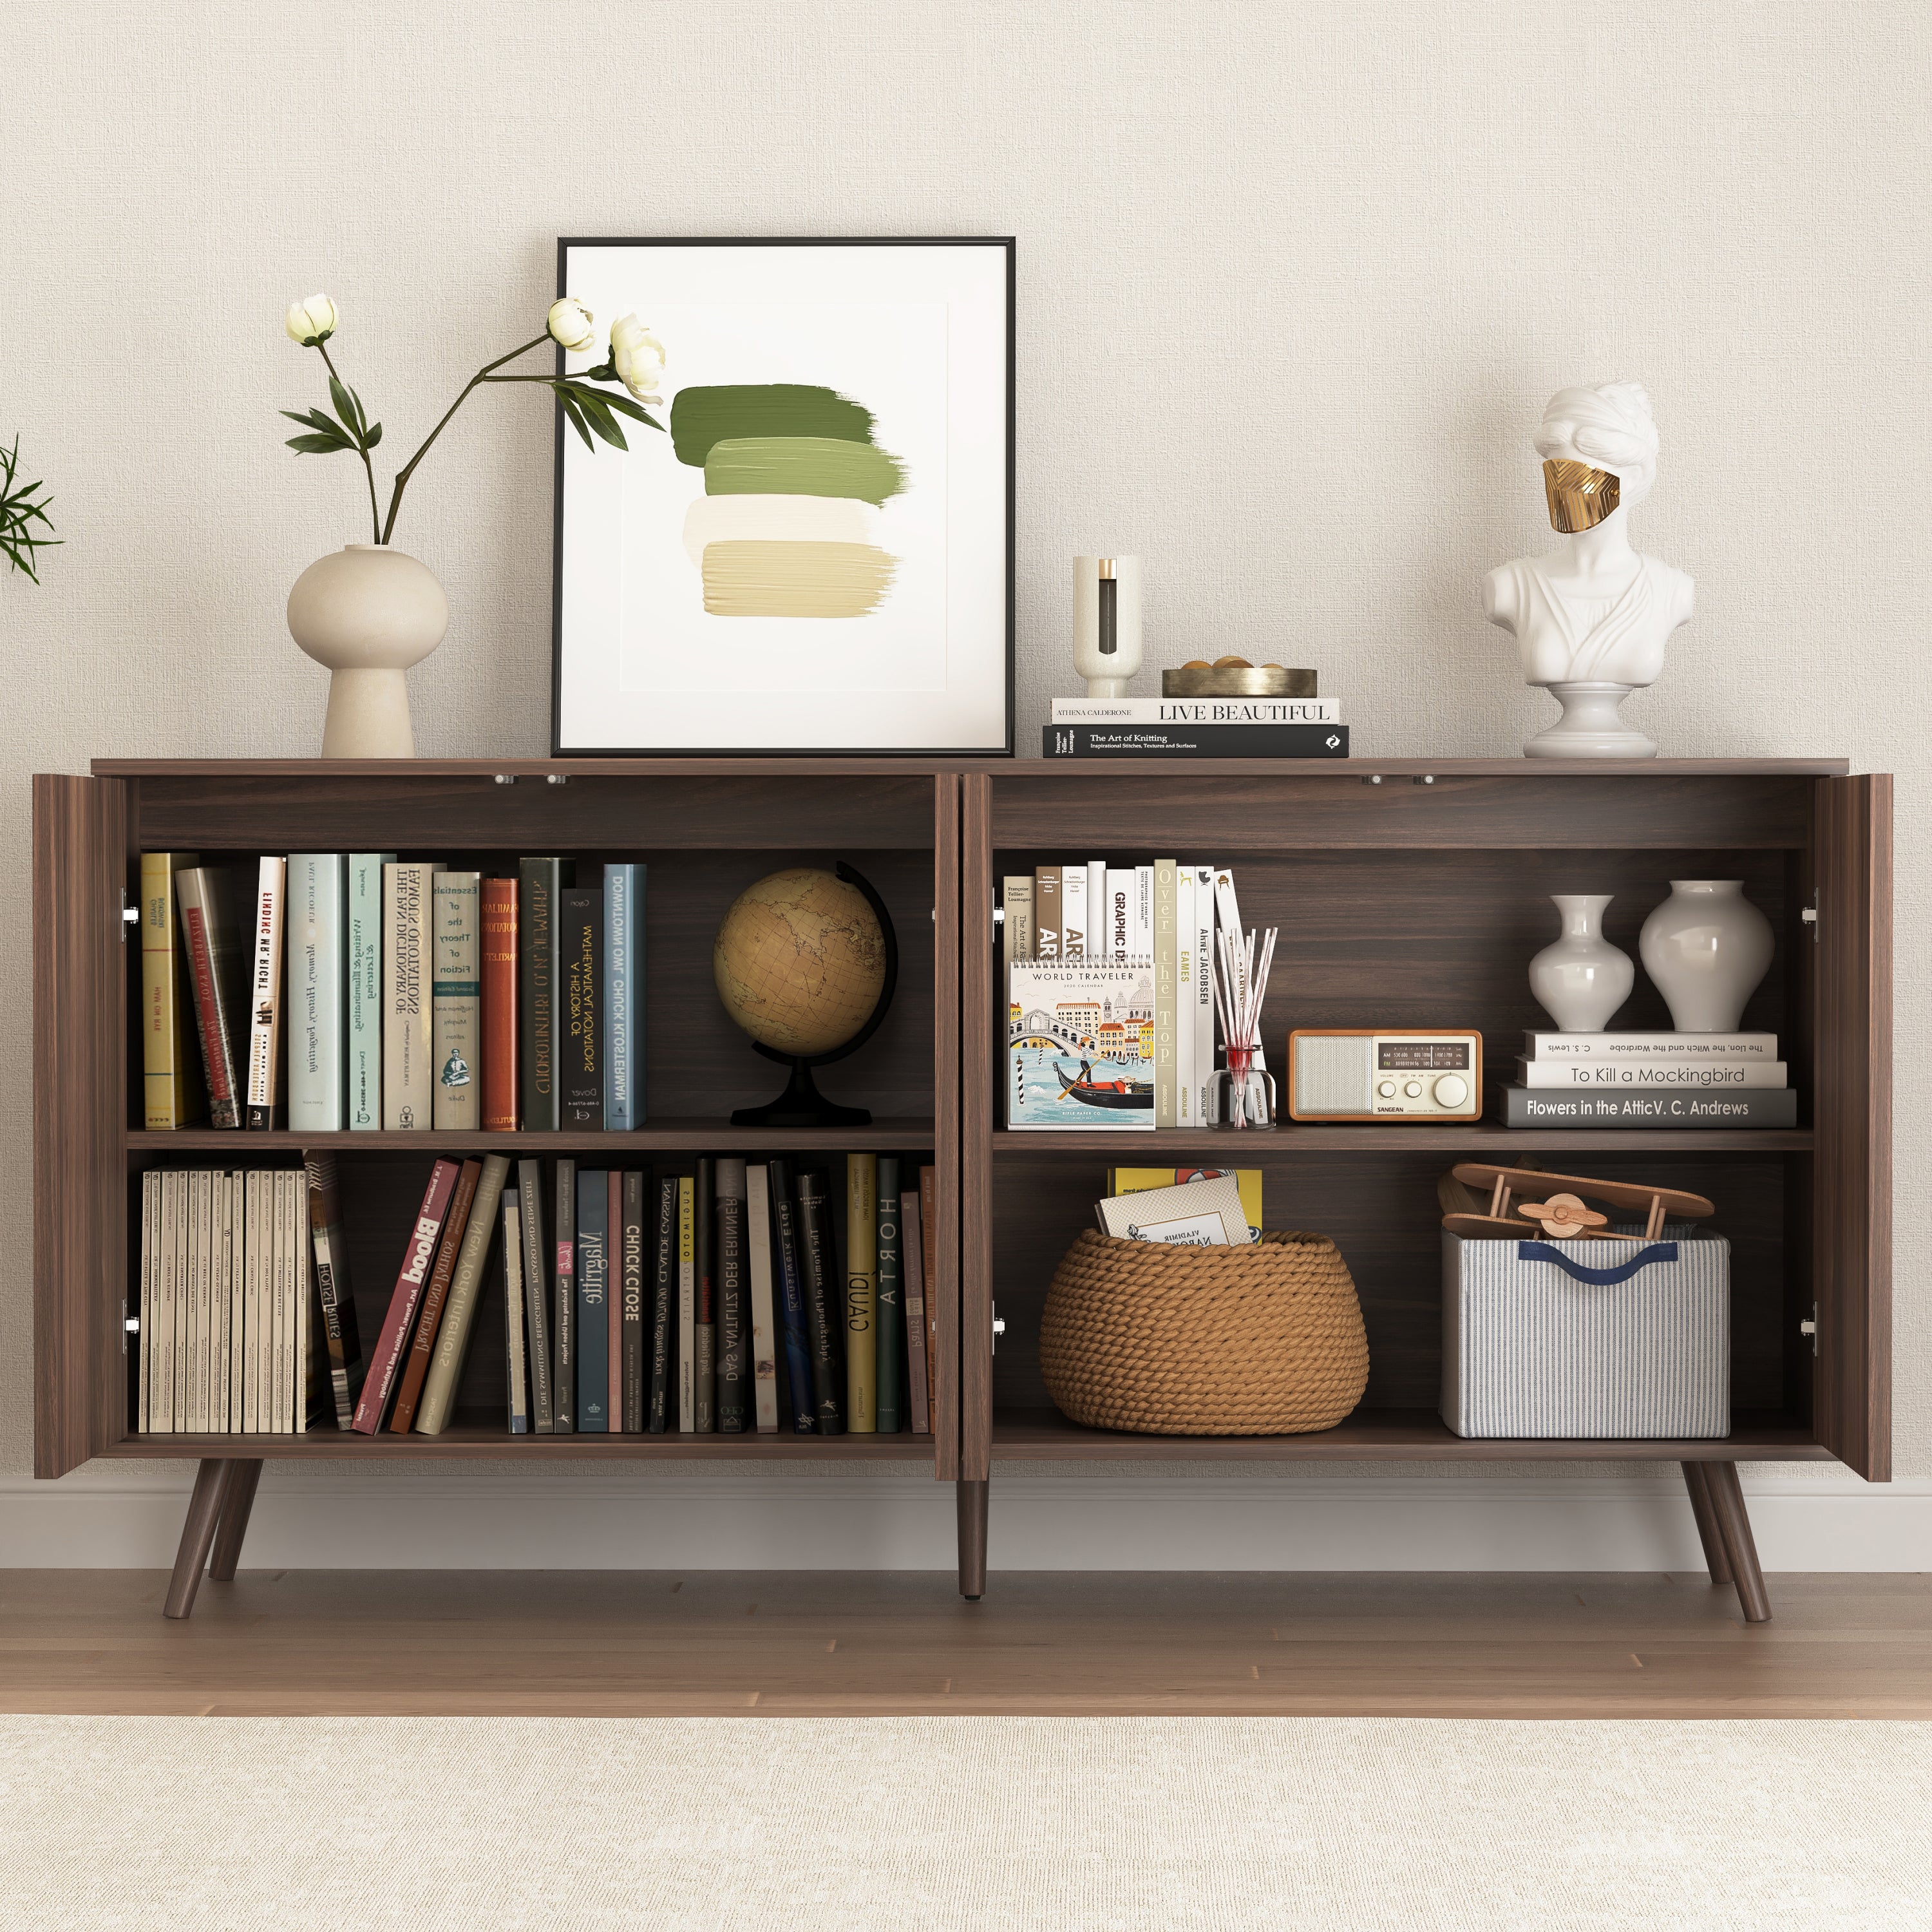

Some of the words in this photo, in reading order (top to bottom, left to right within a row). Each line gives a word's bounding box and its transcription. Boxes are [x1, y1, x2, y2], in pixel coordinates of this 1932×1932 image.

[1160, 706, 1206, 720] LIVE
[1213, 706, 1329, 720] BEAUTIFUL
[1134, 734, 1167, 743] Knitting
[1159, 869, 1171, 930] Over
[1115, 893, 1125, 945] GRAPHIC
[1161, 950, 1170, 994] the
[1180, 949, 1190, 982] EAMES
[1200, 957, 1208, 1004] JACOBSEN
[1160, 1010, 1171, 1063] Top
[1571, 1068, 1590, 1082] To
[1597, 1068, 1615, 1082] Kill
[1622, 1071, 1632, 1082] a
[1639, 1068, 1744, 1085] Mockingbird
[1528, 1100, 1576, 1115] Flowers
[1581, 1100, 1592, 1115] in
[1596, 1100, 1617, 1115] the
[1671, 1100, 1685, 1115] C.
[1690, 1101, 1748, 1115] Andrews
